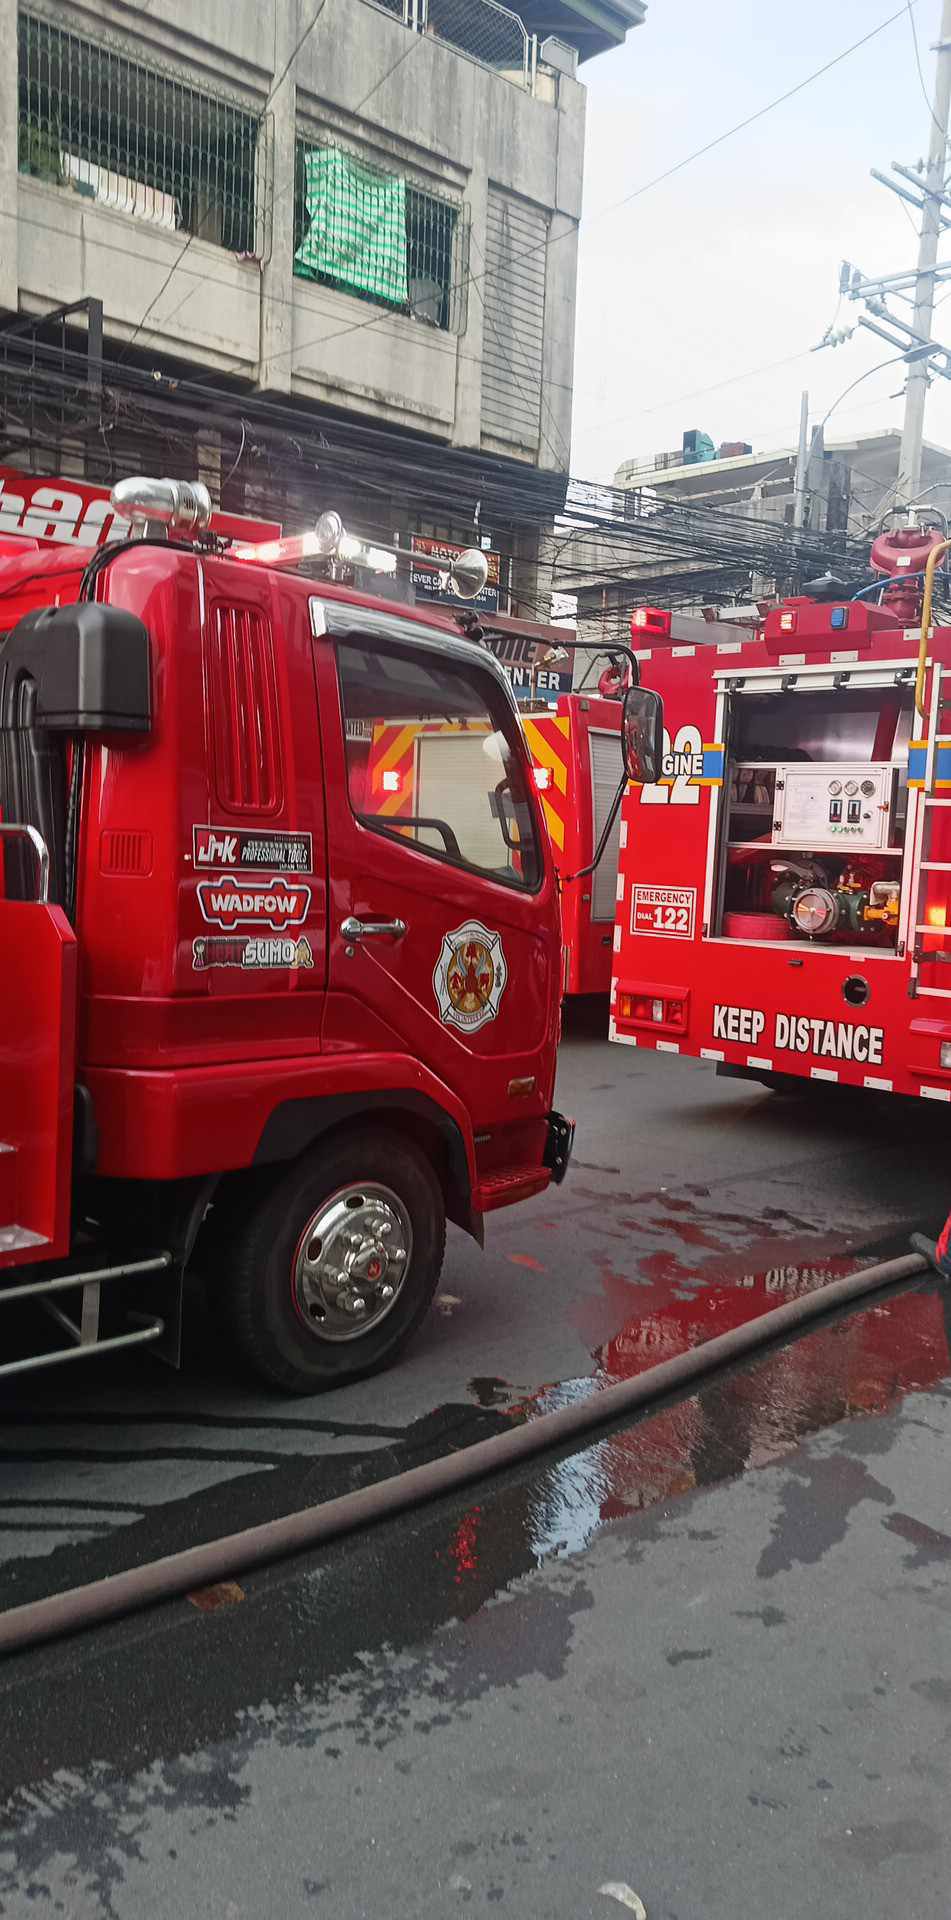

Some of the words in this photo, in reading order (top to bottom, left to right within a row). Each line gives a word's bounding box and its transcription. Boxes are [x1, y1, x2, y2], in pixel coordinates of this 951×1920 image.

[413, 573, 432, 585] EVER
[661, 753, 704, 776] GINE
[241, 845, 286, 863] PROFESSIONAL
[287, 848, 308, 863] TOOLS
[210, 893, 298, 914] WADFOW
[636, 890, 691, 904] EMERGENCY
[637, 911, 653, 921] DIAL
[653, 906, 689, 931] 122
[245, 941, 295, 963] SUMO
[713, 1004, 765, 1044] KEEP
[774, 1013, 883, 1064] DISTANCE
